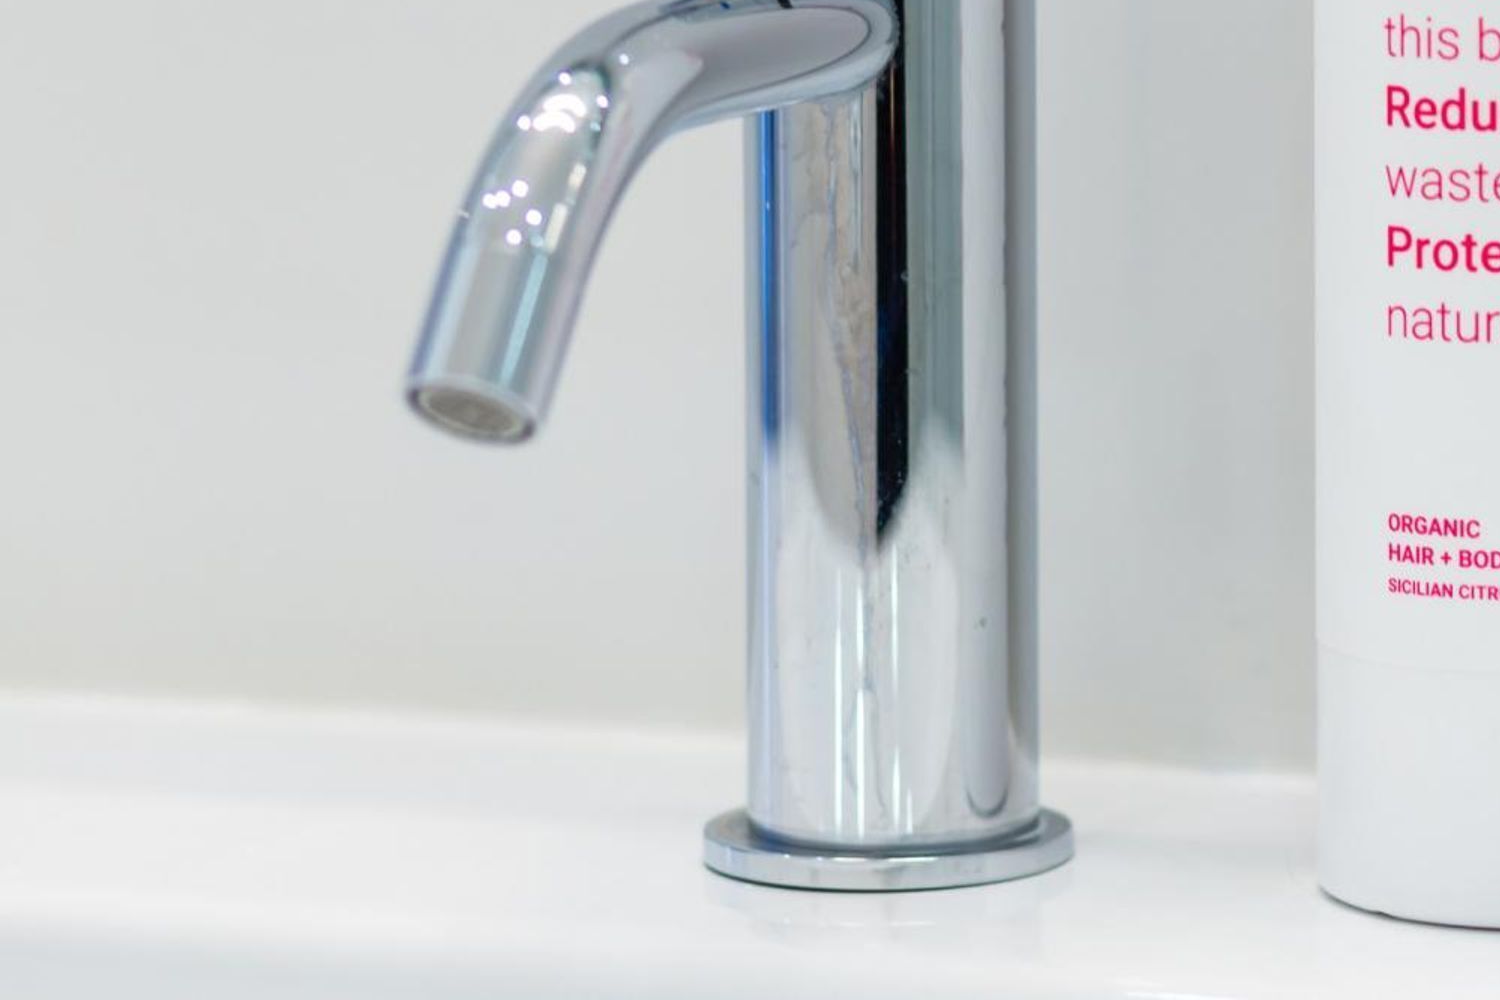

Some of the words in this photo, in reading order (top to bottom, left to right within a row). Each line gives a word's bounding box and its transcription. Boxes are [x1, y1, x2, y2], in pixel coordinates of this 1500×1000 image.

[1384, 13, 1461, 62] this
[1387, 512, 1482, 539] ORGANIC
[1387, 542, 1435, 566] HAIR
[1440, 551, 1453, 566] +
[1387, 577, 1454, 599] SICILIAN
